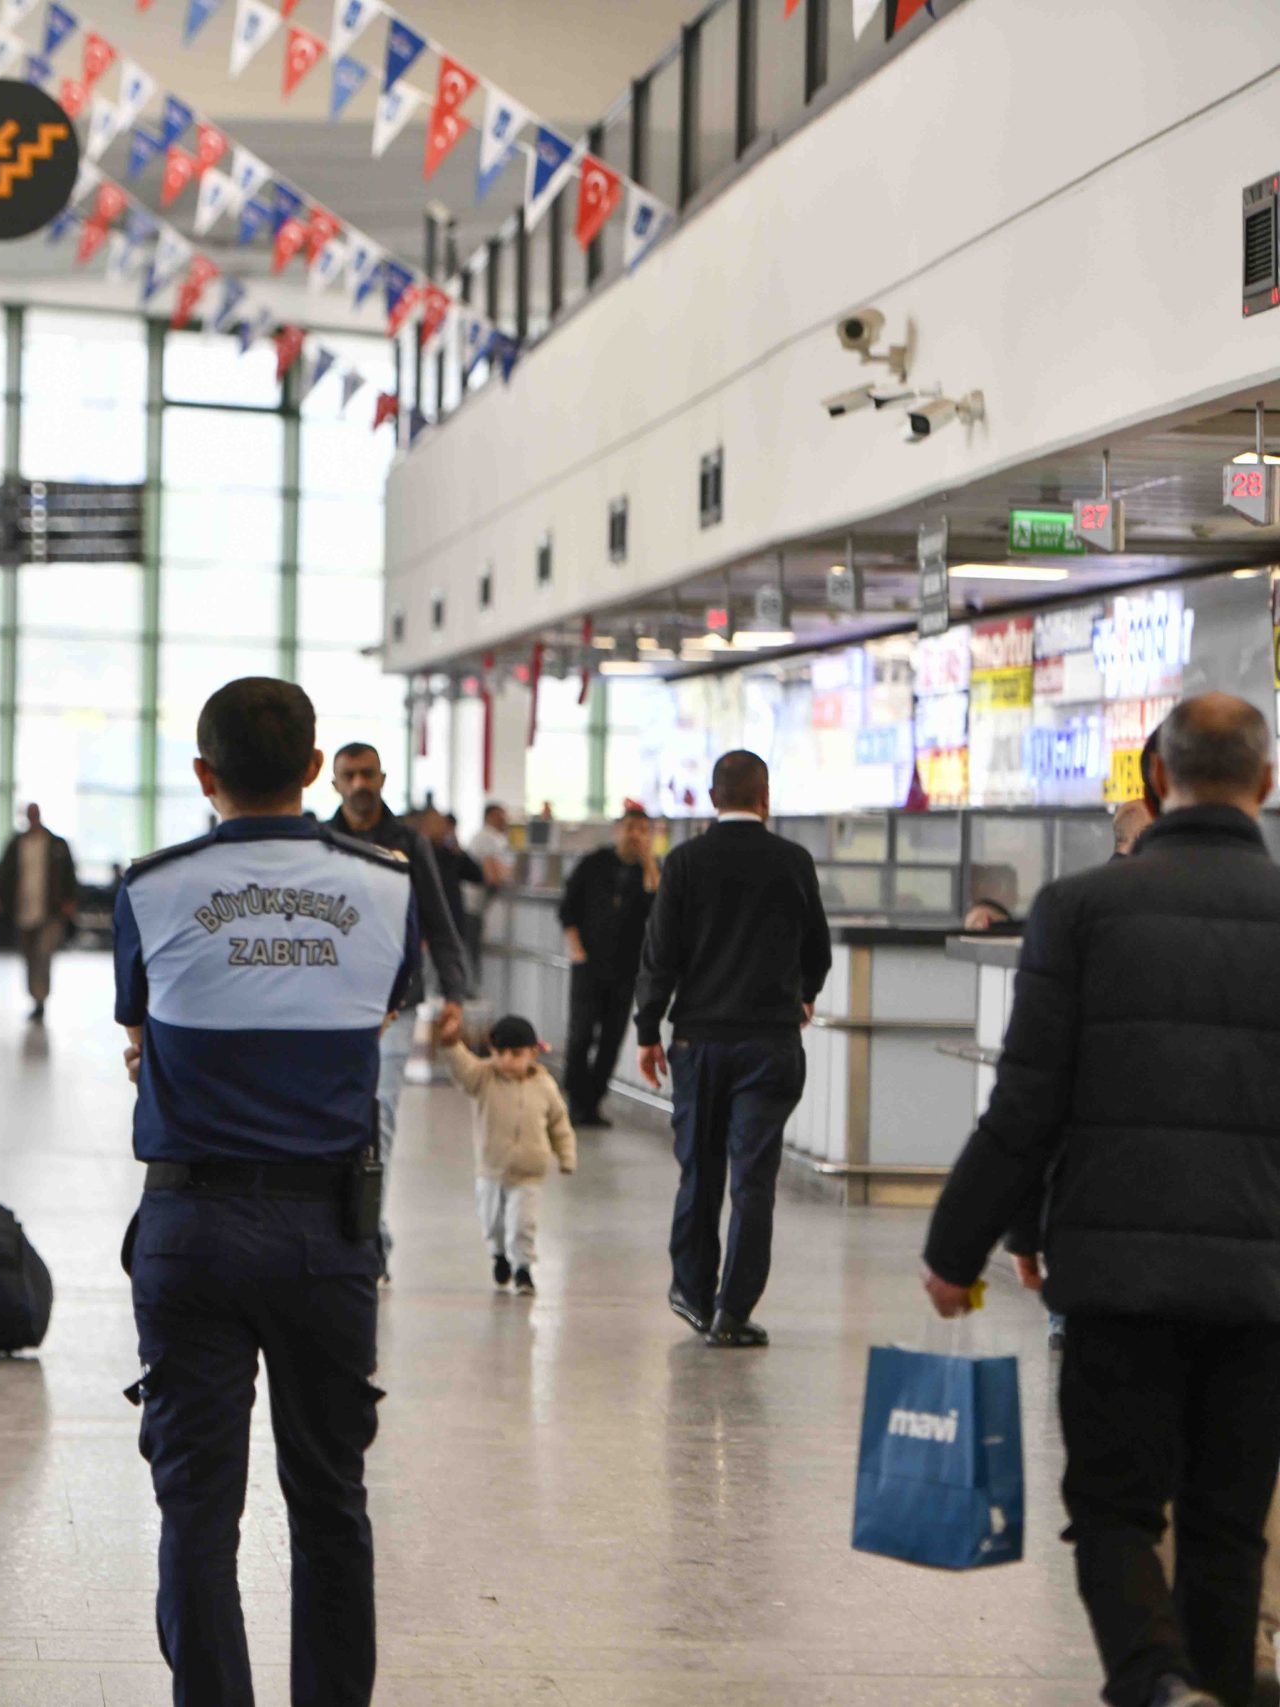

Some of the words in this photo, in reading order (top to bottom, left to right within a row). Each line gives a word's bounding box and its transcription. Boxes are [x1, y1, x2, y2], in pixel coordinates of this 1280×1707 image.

[1231, 471, 1263, 497] 28
[1080, 504, 1110, 529] 27
[194, 883, 361, 936] BÜYÜKŞEHİR
[228, 937, 339, 966] ZABITA
[887, 1408, 959, 1444] mavi
